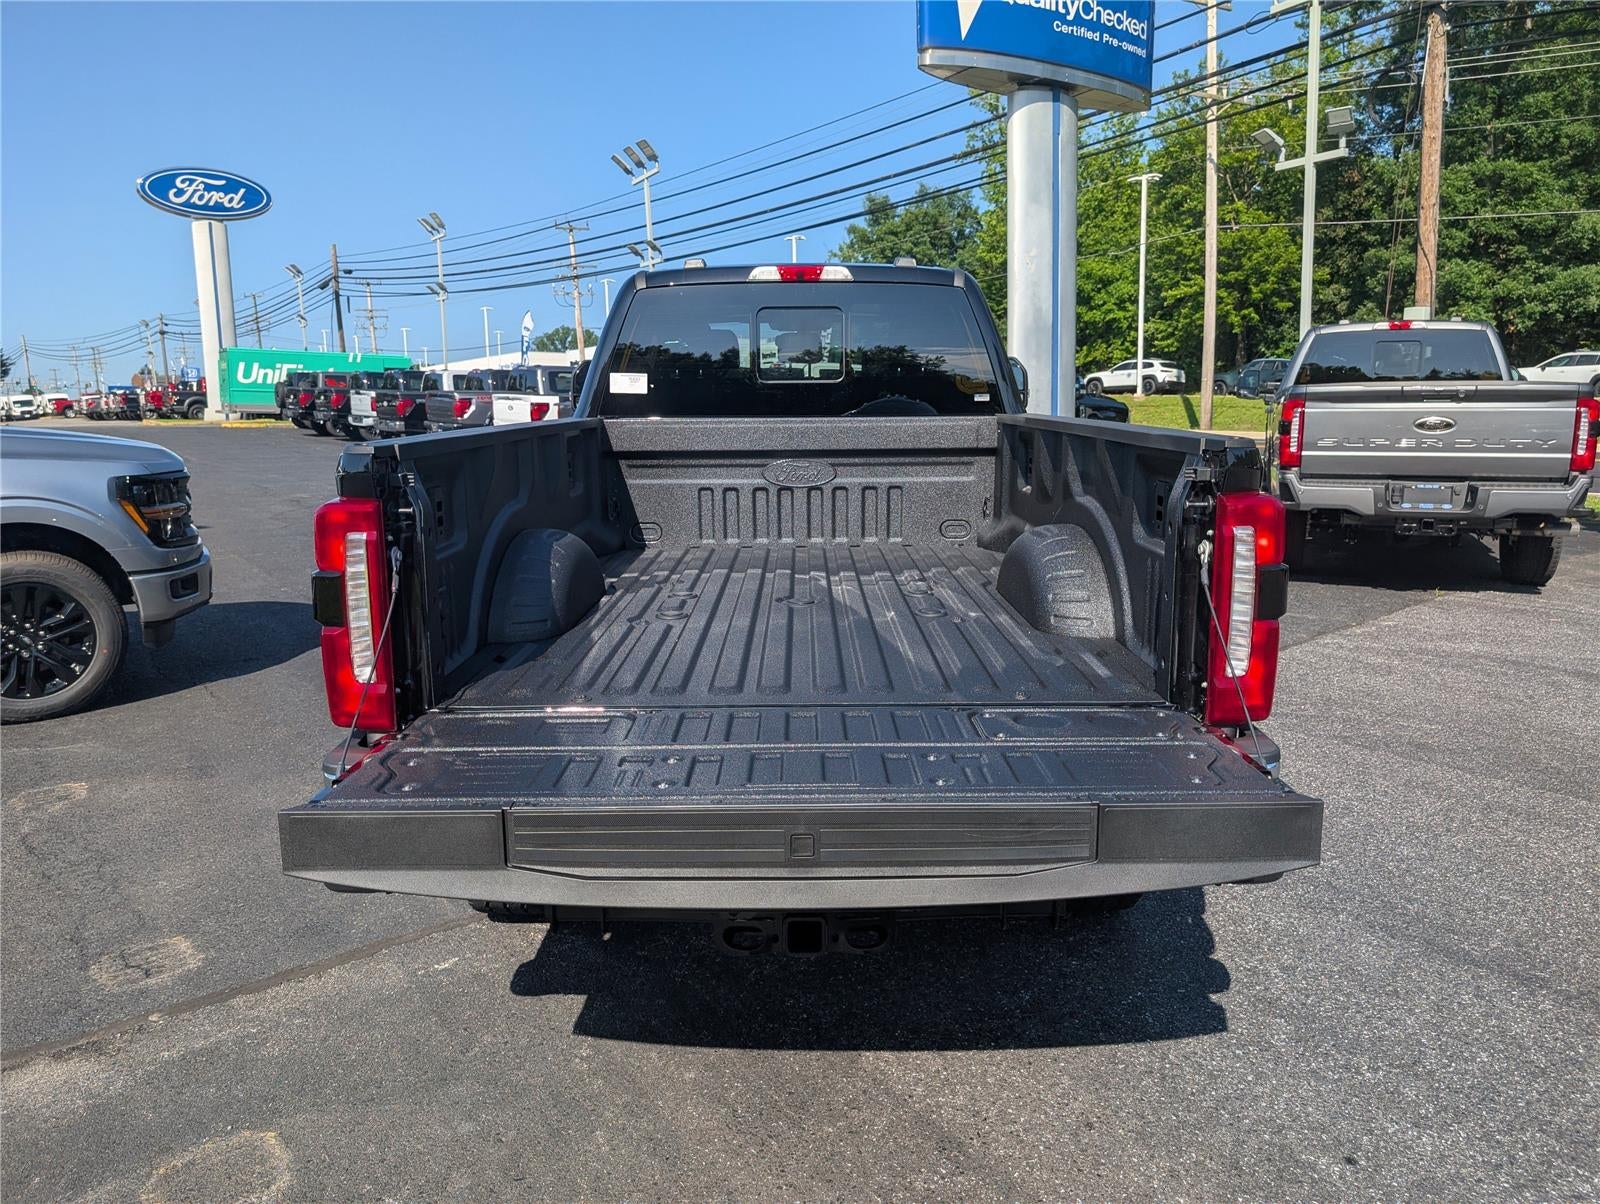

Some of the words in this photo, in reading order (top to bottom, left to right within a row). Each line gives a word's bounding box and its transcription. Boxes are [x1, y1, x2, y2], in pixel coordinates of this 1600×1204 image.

[1006, 0, 1147, 40] alityChecked
[1053, 20, 1100, 42] Certified
[1102, 33, 1147, 58] Pre-owned
[168, 175, 247, 209] Ford
[235, 361, 334, 385] UniF
[1316, 437, 1443, 448] SUPER
[1453, 438, 1557, 448] DUTY
[776, 463, 824, 481] Ford
